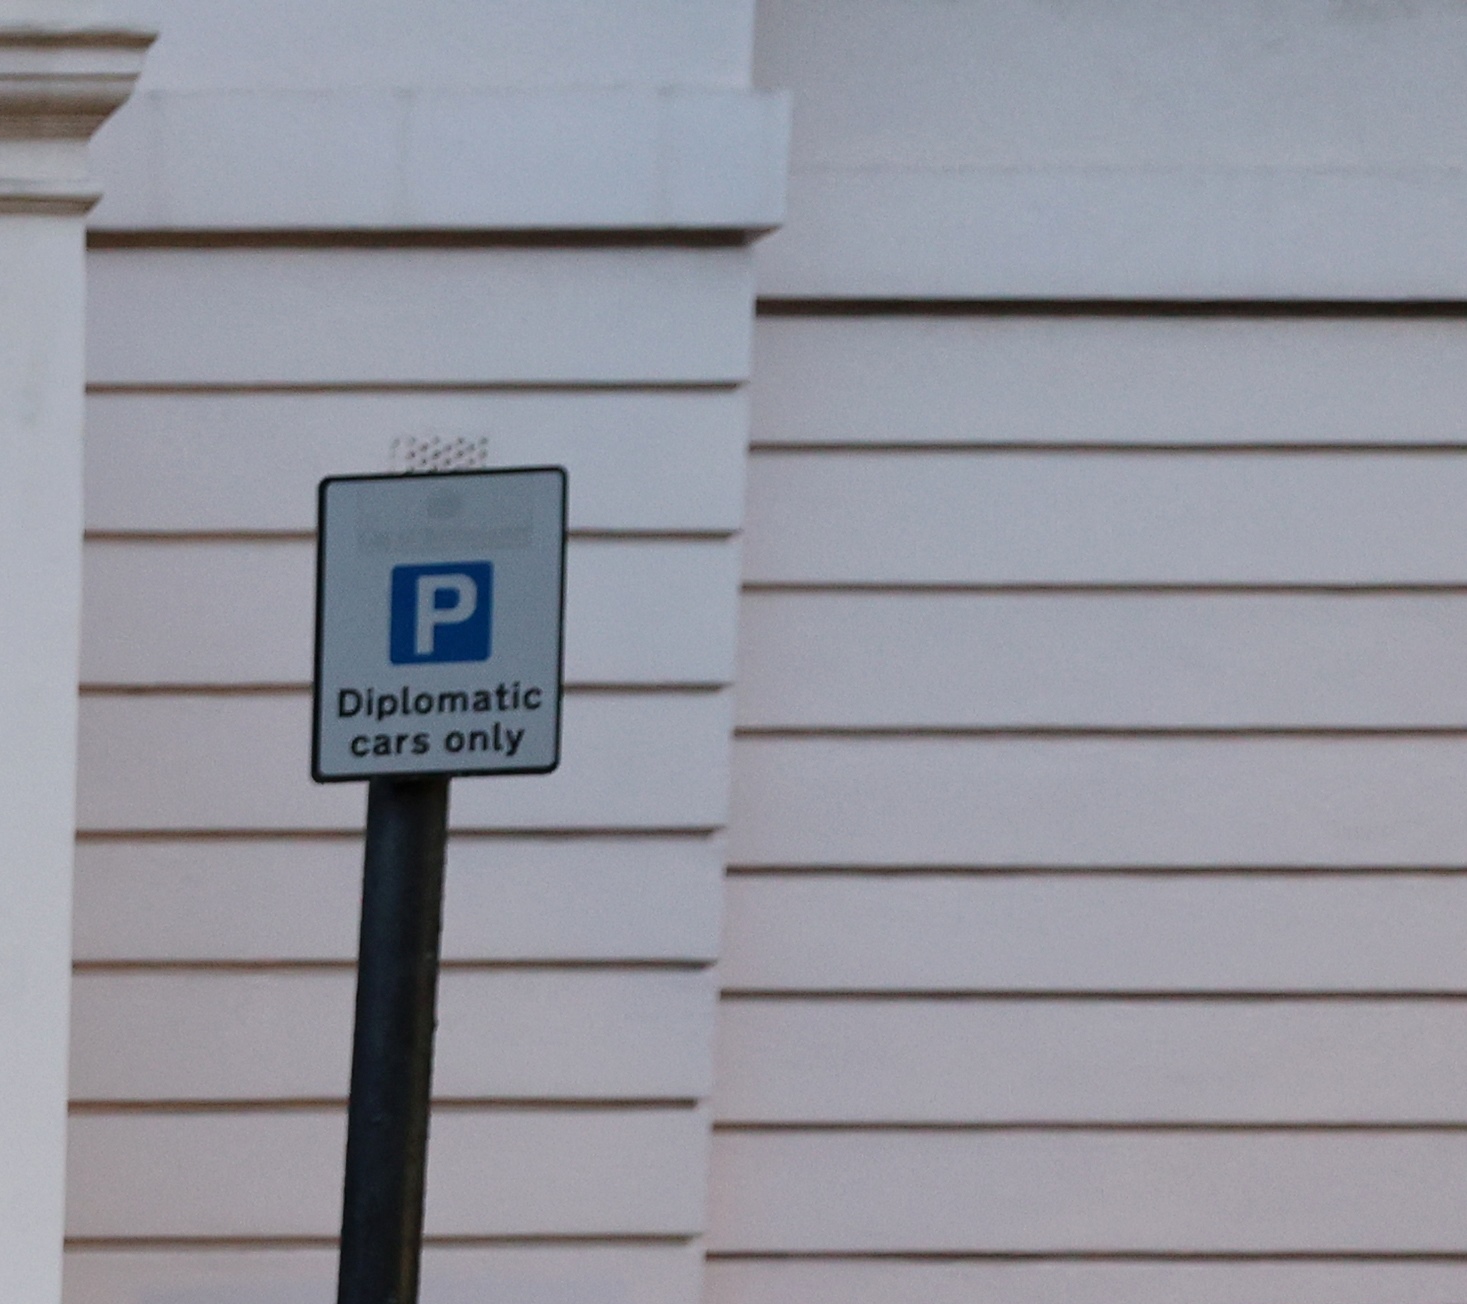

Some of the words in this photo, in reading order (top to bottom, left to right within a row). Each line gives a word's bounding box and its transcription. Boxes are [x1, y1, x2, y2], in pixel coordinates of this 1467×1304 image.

[413, 572, 478, 656] P
[337, 682, 543, 721] Diplomatic
[350, 732, 431, 758] cars
[443, 722, 526, 757] only
